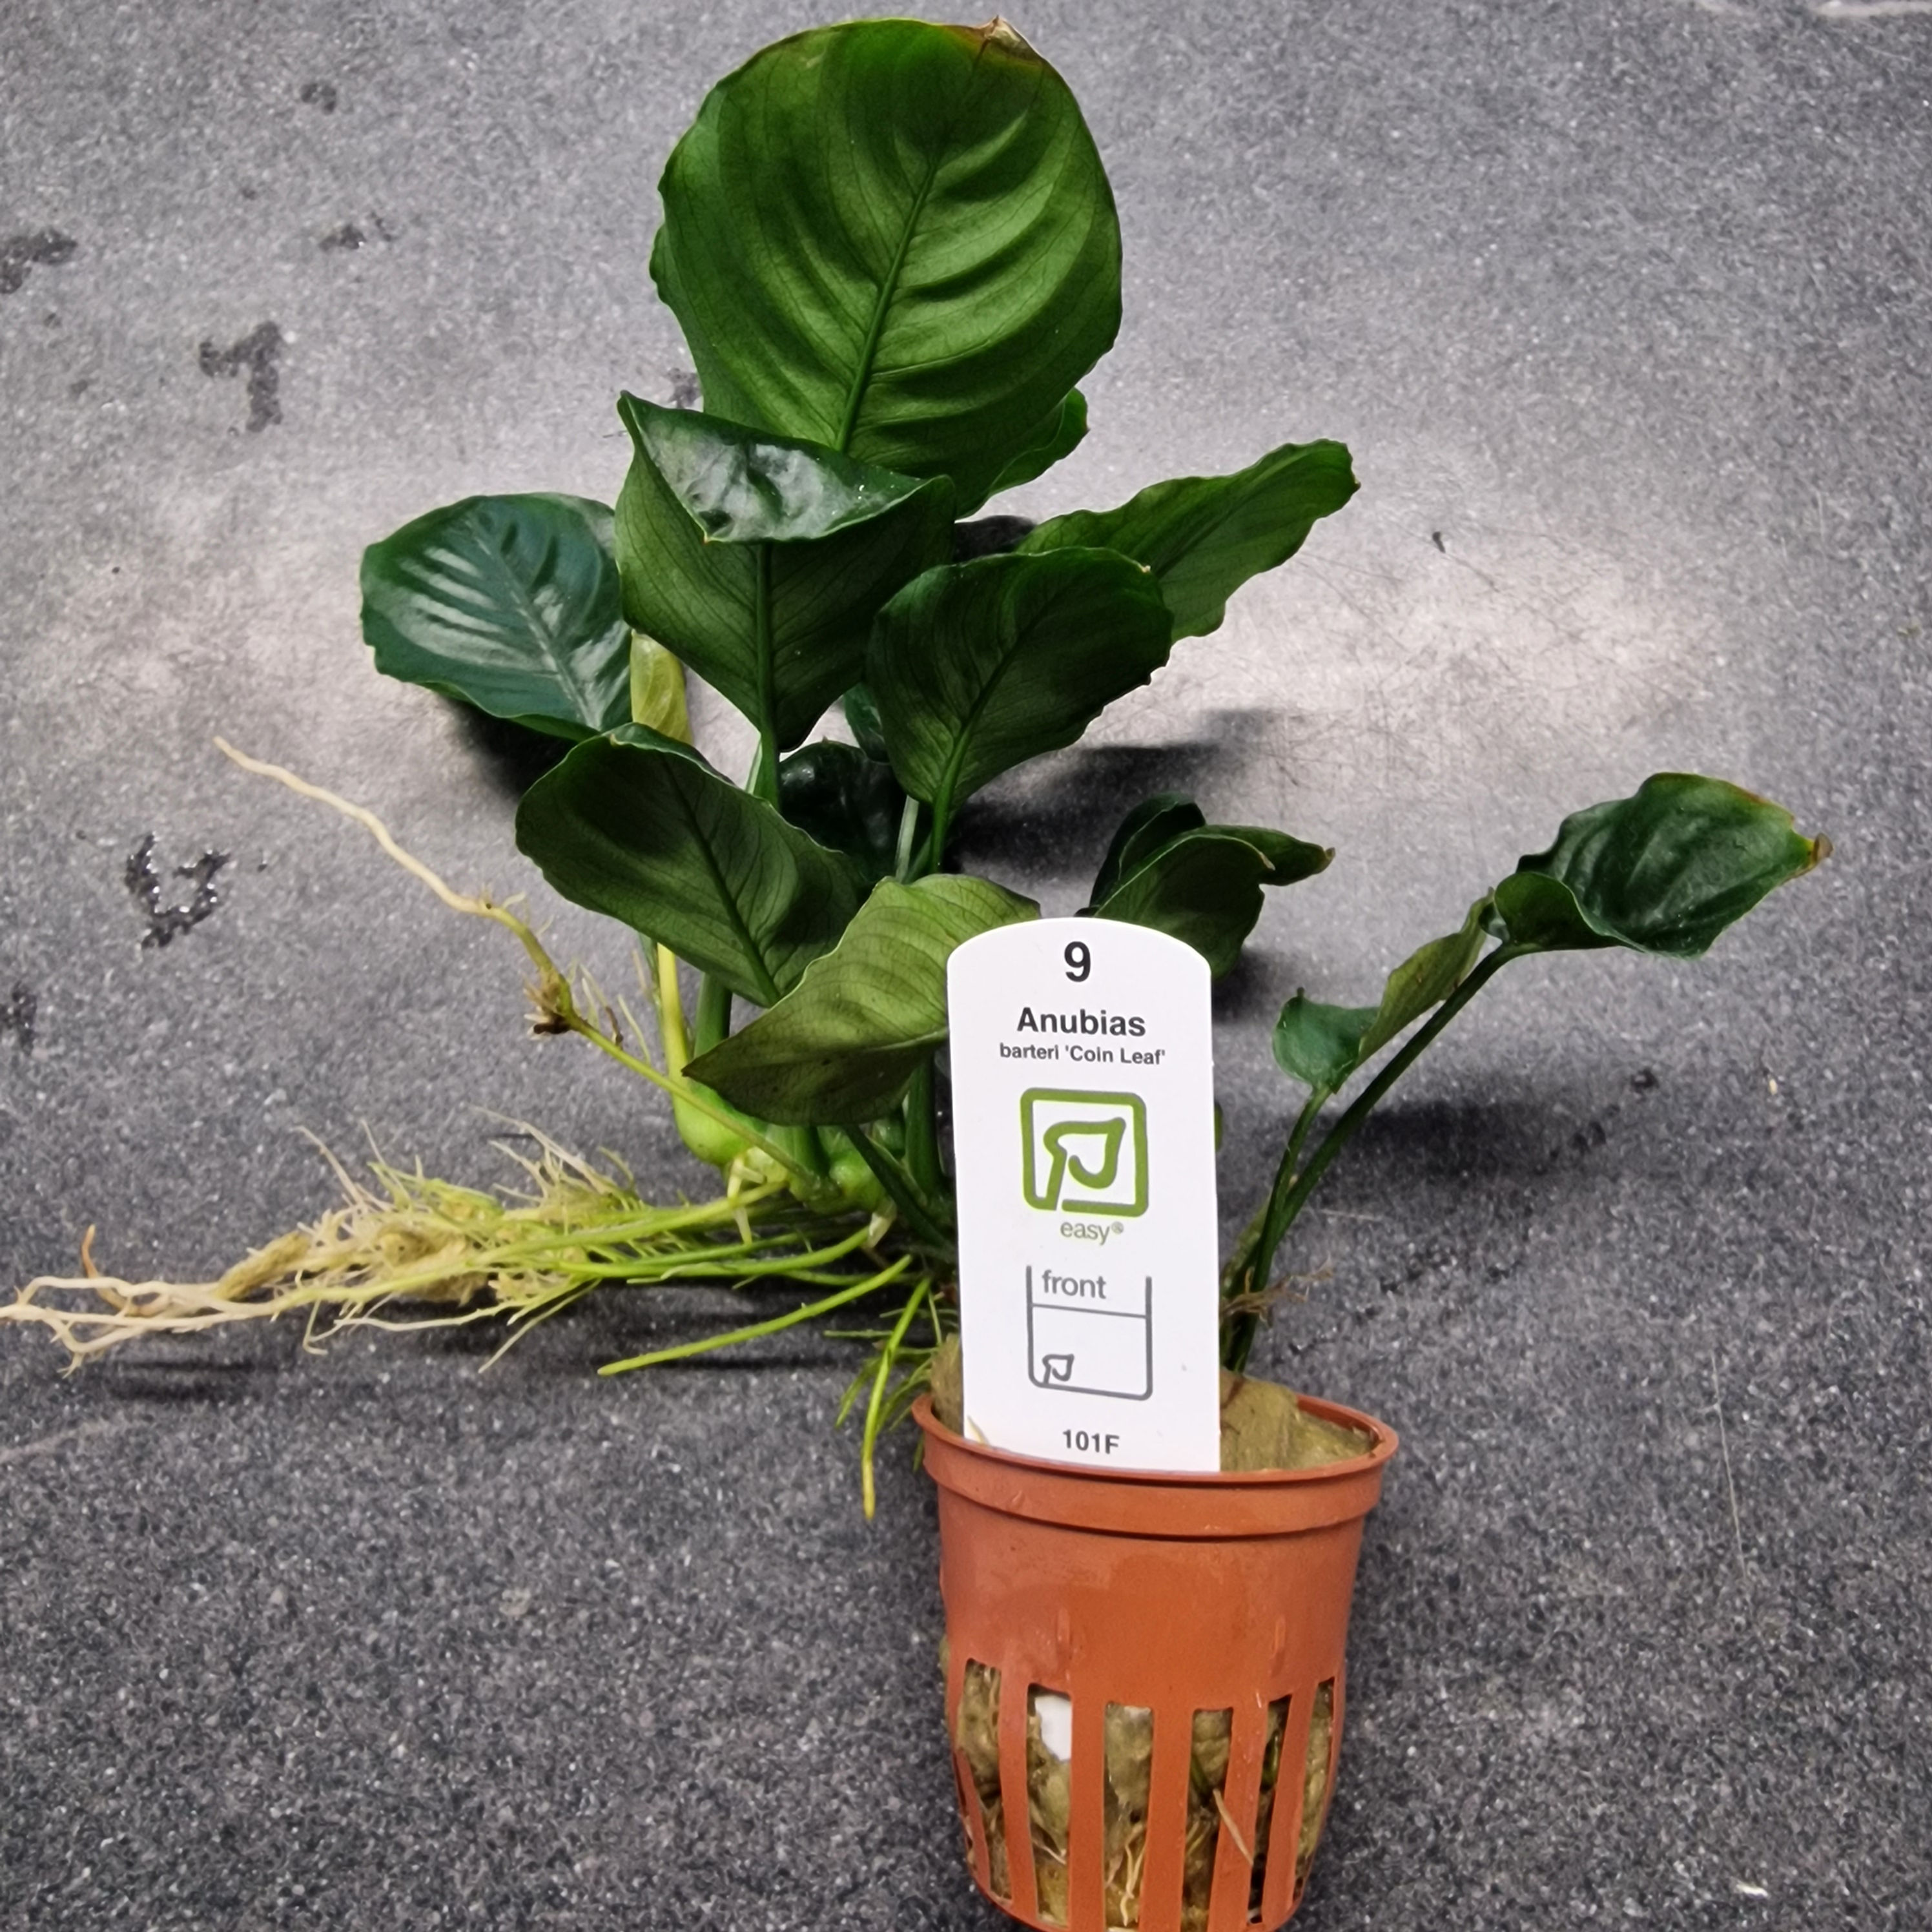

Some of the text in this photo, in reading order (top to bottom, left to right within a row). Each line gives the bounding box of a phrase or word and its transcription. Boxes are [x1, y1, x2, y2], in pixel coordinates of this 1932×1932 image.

[1064, 941, 1091, 982] 9
[1016, 1007, 1146, 1037] Anubias
[999, 1042, 1166, 1065] barteri 'Coin Leaf'
[1041, 1269, 1107, 1299] front
[1062, 1429, 1120, 1454] 101F
